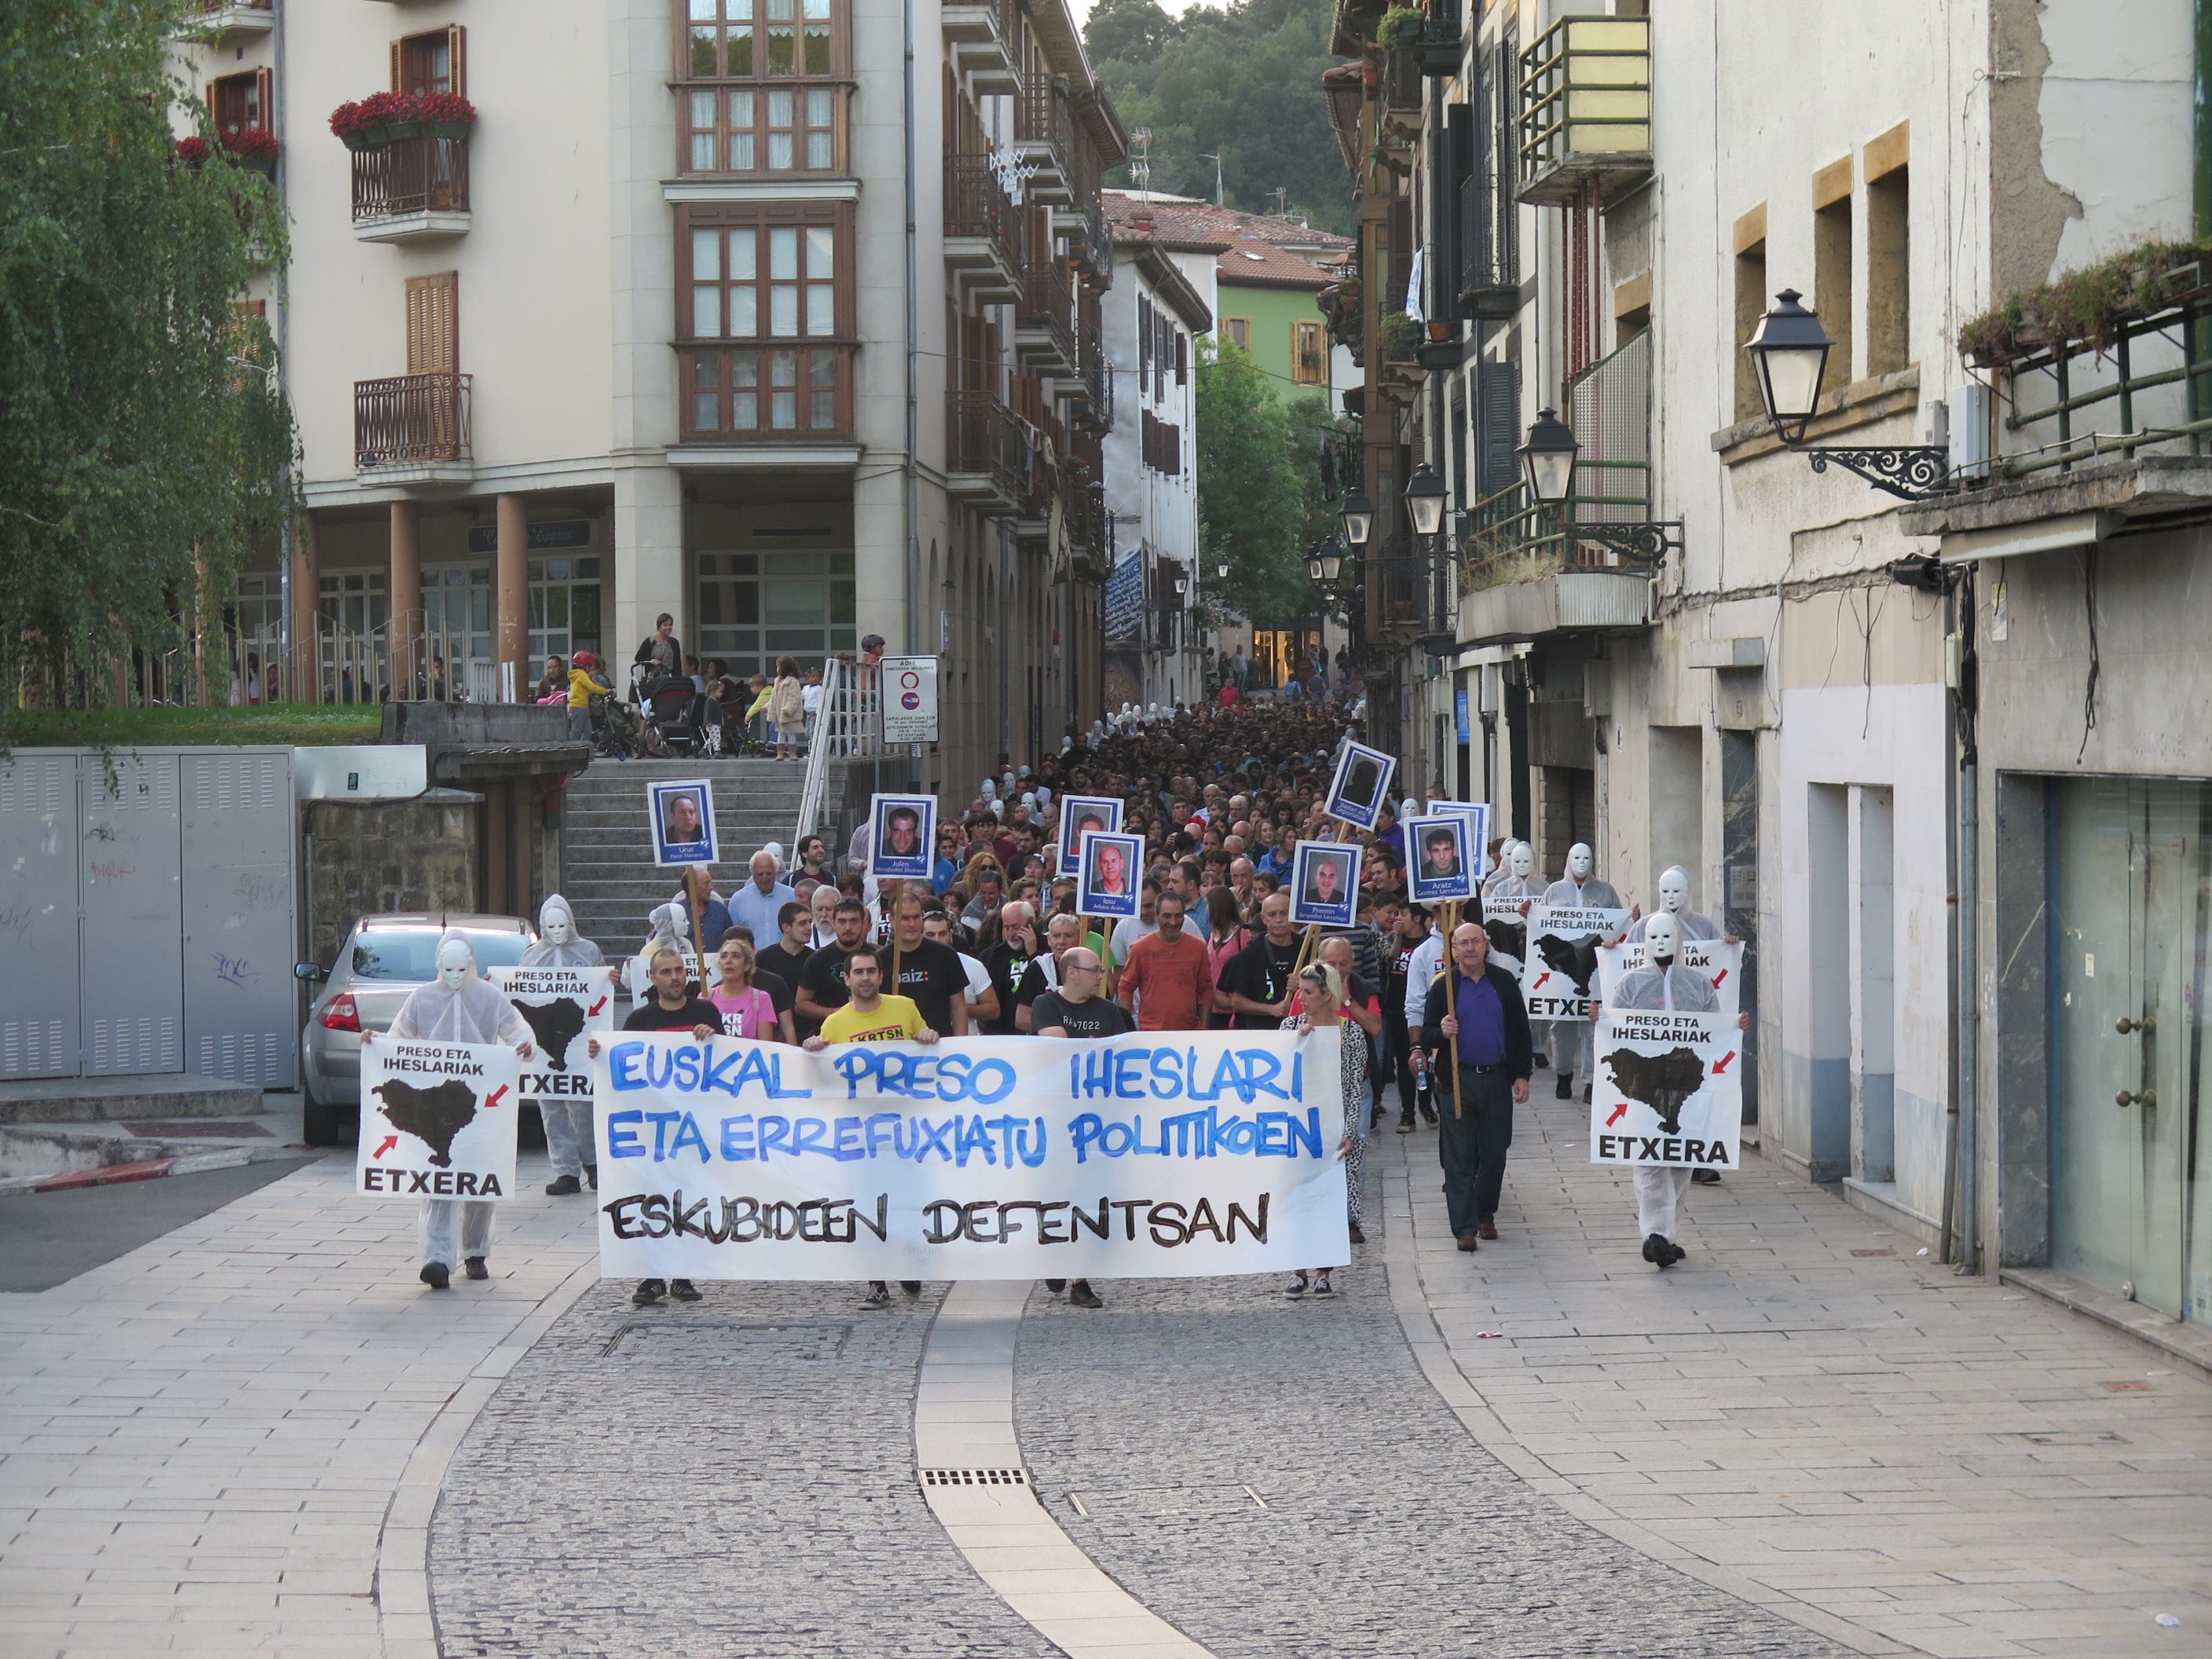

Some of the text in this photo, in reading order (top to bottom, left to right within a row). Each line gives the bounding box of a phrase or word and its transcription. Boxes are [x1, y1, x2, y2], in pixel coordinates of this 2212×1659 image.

[1312, 906, 1335, 915] Premin
[1485, 905, 1519, 914] IHESL
[1550, 910, 1605, 920] PRESO ETA
[1540, 919, 1614, 931] IHESLARIAK
[1683, 946, 1698, 954] TA
[515, 971, 578, 981] PRESO ETA
[503, 982, 589, 994] IHESLARIAK
[1529, 998, 1602, 1016] ETXE
[721, 1013, 742, 1024] KR
[1625, 1016, 1700, 1028] PRESO ETA
[723, 1024, 742, 1036] SN
[851, 1028, 904, 1042] KRTSN
[1612, 1027, 1712, 1044] IHESLARIAK
[396, 1046, 472, 1060] PRESO ETA
[383, 1057, 484, 1076] IHESLARIAK
[609, 1040, 1304, 1105] EUSKAL PRESO IHESLARI
[518, 1074, 594, 1096] TXER
[608, 1105, 1324, 1169] ETA ERREFUXIATU POLITIKOEN
[1599, 1135, 1730, 1164] ETXERA
[364, 1167, 503, 1197] ETXERA
[602, 1188, 1270, 1248] ESKUBIDEEN DEFENTSAN
